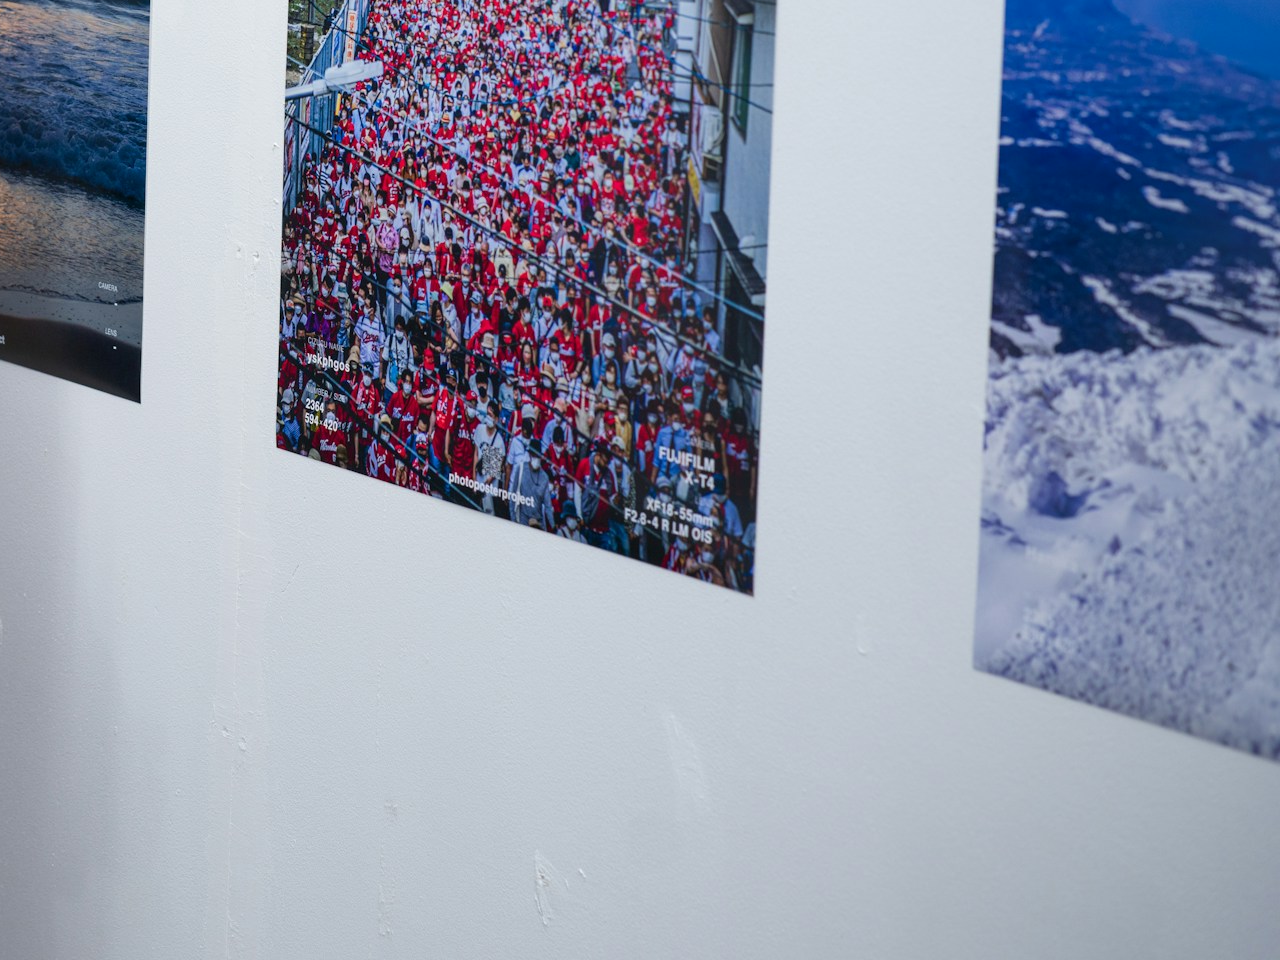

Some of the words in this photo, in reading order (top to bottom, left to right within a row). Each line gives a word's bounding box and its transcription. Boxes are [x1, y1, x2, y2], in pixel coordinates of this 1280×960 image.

[98, 281, 118, 293] CAMERA
[104, 327, 118, 337] LENS
[307, 352, 351, 373] yskphgos
[305, 398, 325, 413] 2364
[658, 445, 715, 473] FUJIFILM
[448, 472, 535, 508] photoposterproject
[686, 470, 715, 491] X-T4
[646, 496, 714, 528] XF18-55mm
[624, 507, 659, 530] F2.8-4
[661, 518, 670, 533] R
[671, 521, 689, 538] LM
[691, 527, 713, 544] OIS
